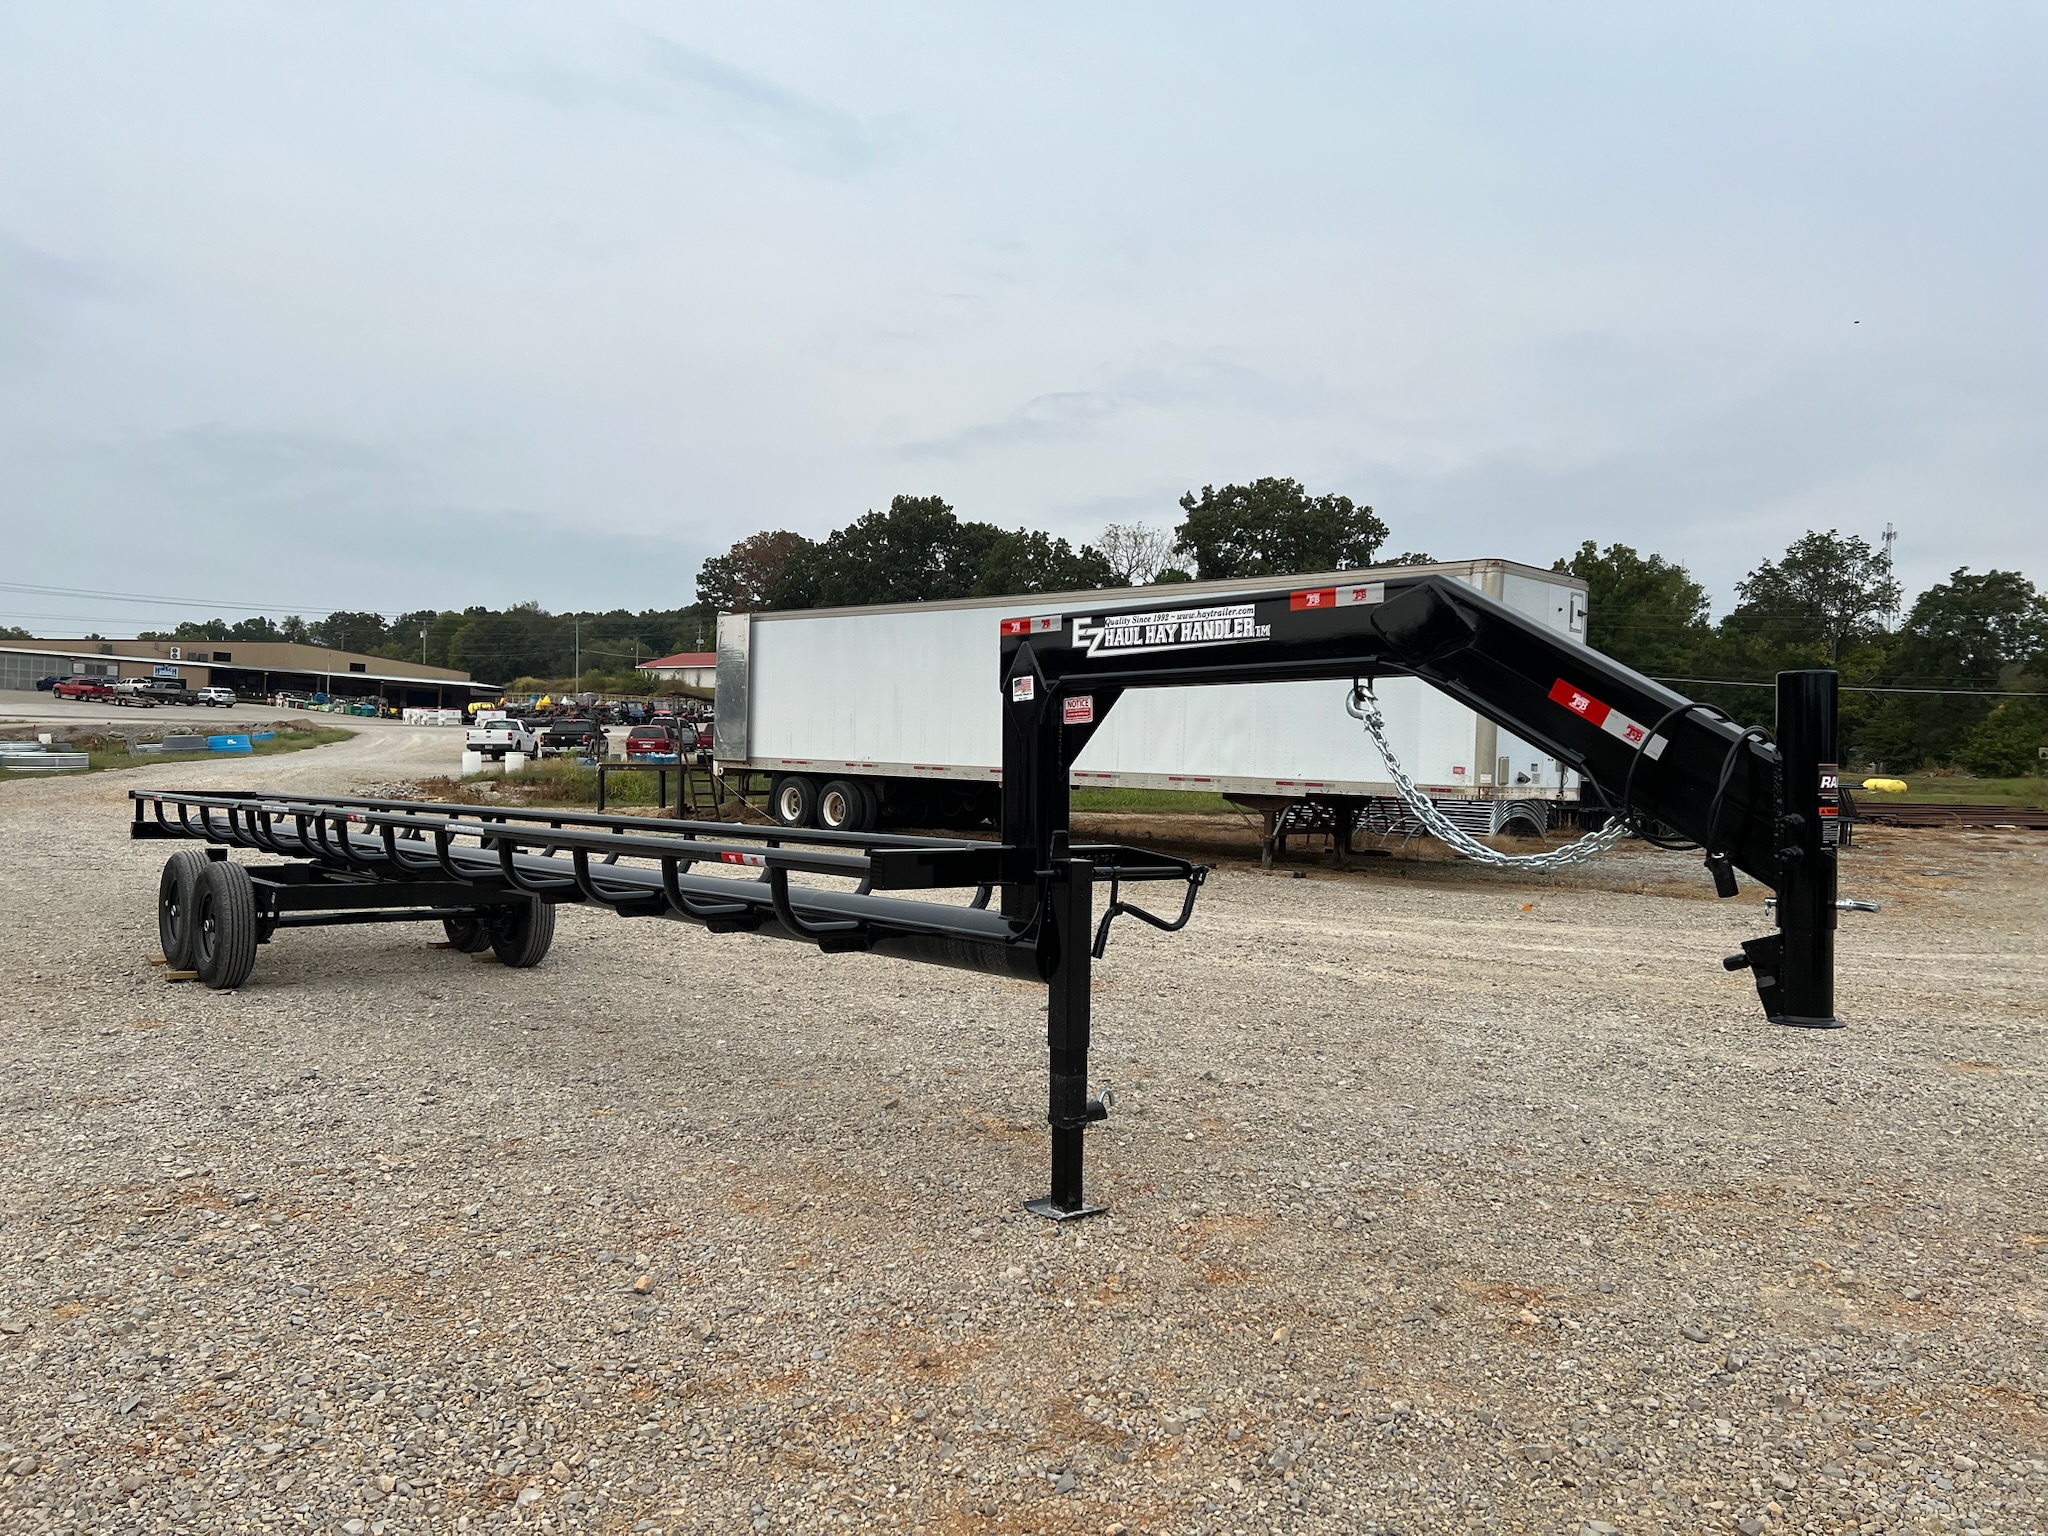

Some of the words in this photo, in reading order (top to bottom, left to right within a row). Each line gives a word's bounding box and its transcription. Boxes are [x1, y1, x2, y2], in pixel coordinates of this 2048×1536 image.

[1105, 617, 1130, 627] Quality
[1132, 616, 1151, 624] Since
[1153, 613, 1169, 622] 1992
[1176, 607, 1254, 620] www.haytrailer.com
[1104, 626, 1143, 647] HAUL
[1145, 623, 1179, 645] HAY
[1180, 617, 1255, 642] HANDLER
[1067, 700, 1089, 708] NOTICE
